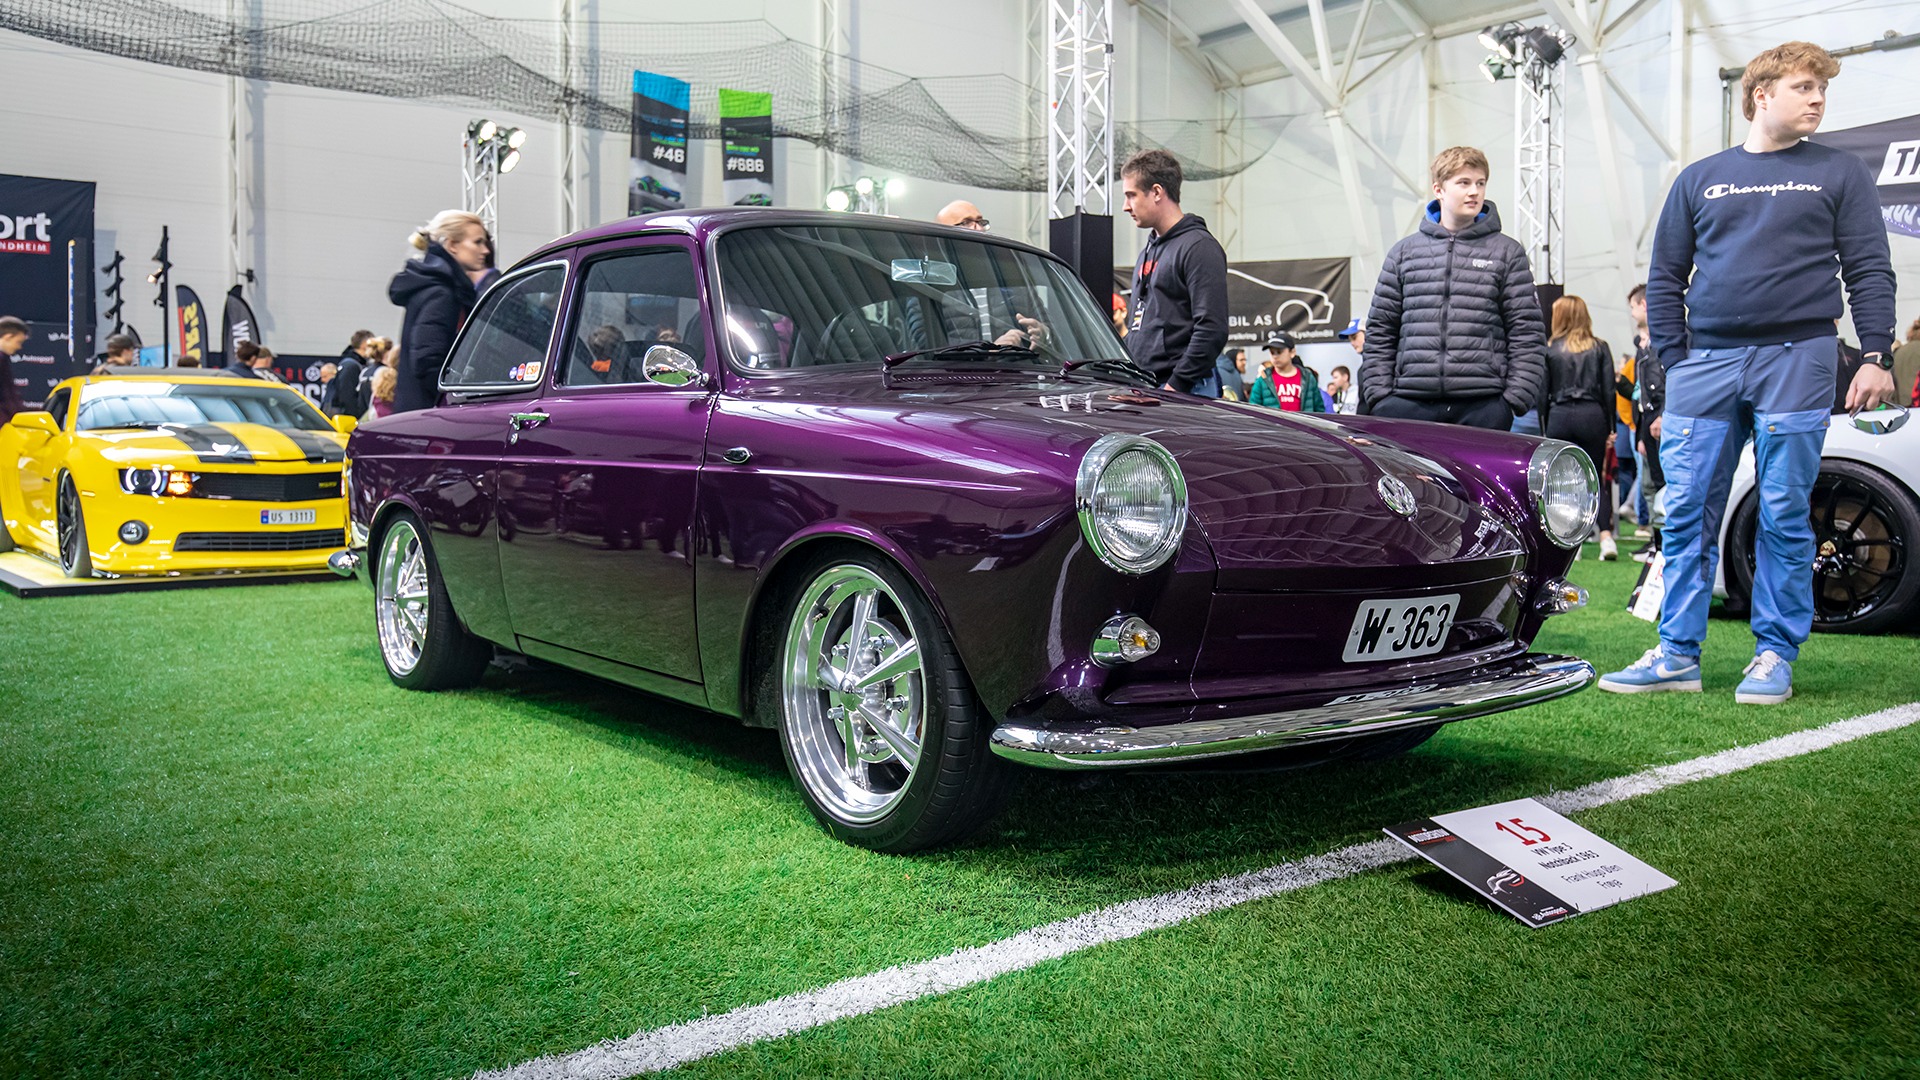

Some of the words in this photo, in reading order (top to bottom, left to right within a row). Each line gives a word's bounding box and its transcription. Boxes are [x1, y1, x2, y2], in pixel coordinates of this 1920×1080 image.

[1704, 181, 1822, 199] Champion
[1254, 314, 1272, 326] AS
[1277, 383, 1302, 398] ANT
[271, 512, 283, 522] US
[1357, 603, 1451, 655] W-363
[1495, 818, 1551, 846] 15
[1530, 847, 1550, 857] VW
[1544, 845, 1568, 855] Type
[1561, 842, 1573, 850] 3
[1538, 855, 1582, 870] Notchback
[1575, 850, 1600, 861] 1963
[1561, 872, 1588, 884] Frank
